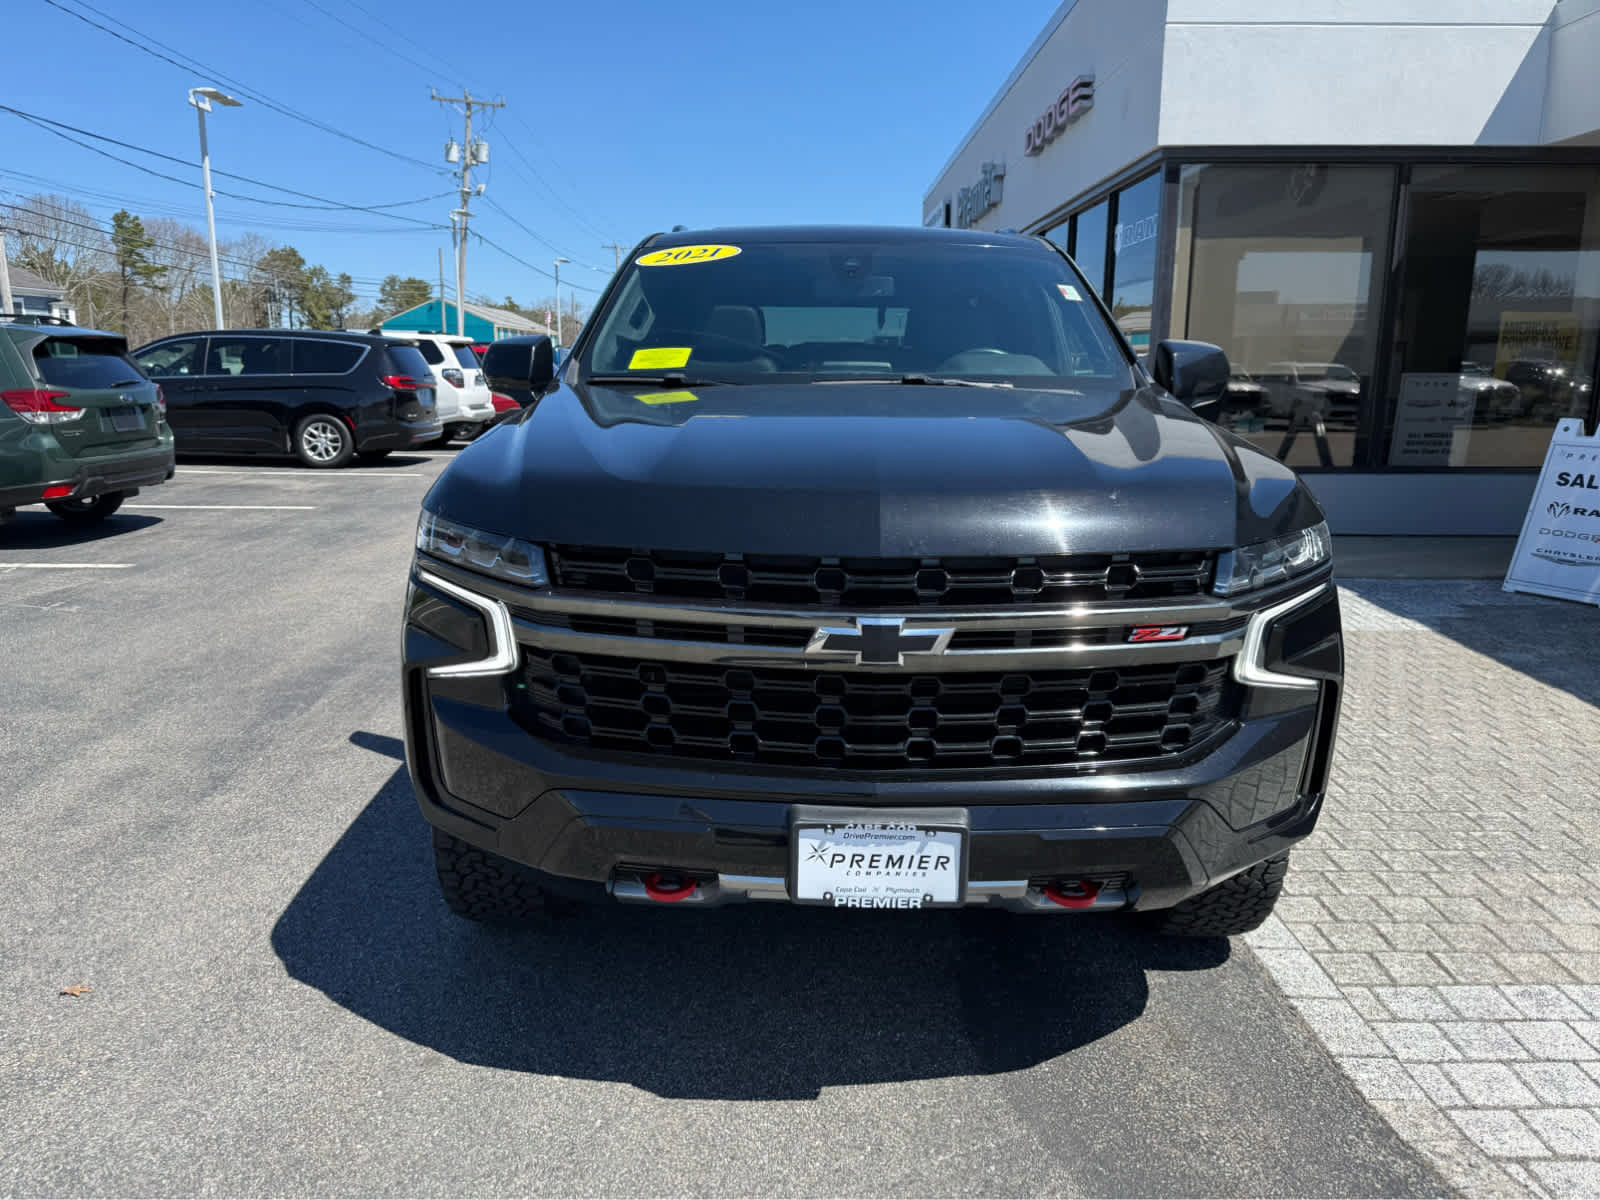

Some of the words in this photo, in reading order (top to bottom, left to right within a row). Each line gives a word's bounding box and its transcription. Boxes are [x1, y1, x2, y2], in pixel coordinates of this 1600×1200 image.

[1024, 75, 1095, 157] DODGE
[655, 247, 722, 263] 2021
[1555, 471, 1600, 490] SAL
[1573, 507, 1600, 518] RA
[1127, 626, 1189, 642] Z71
[843, 832, 916, 840] DrivePremier.com
[829, 853, 951, 871] PREMIER
[885, 886, 921, 895] Plymouth
[834, 896, 922, 909] PREMIER
